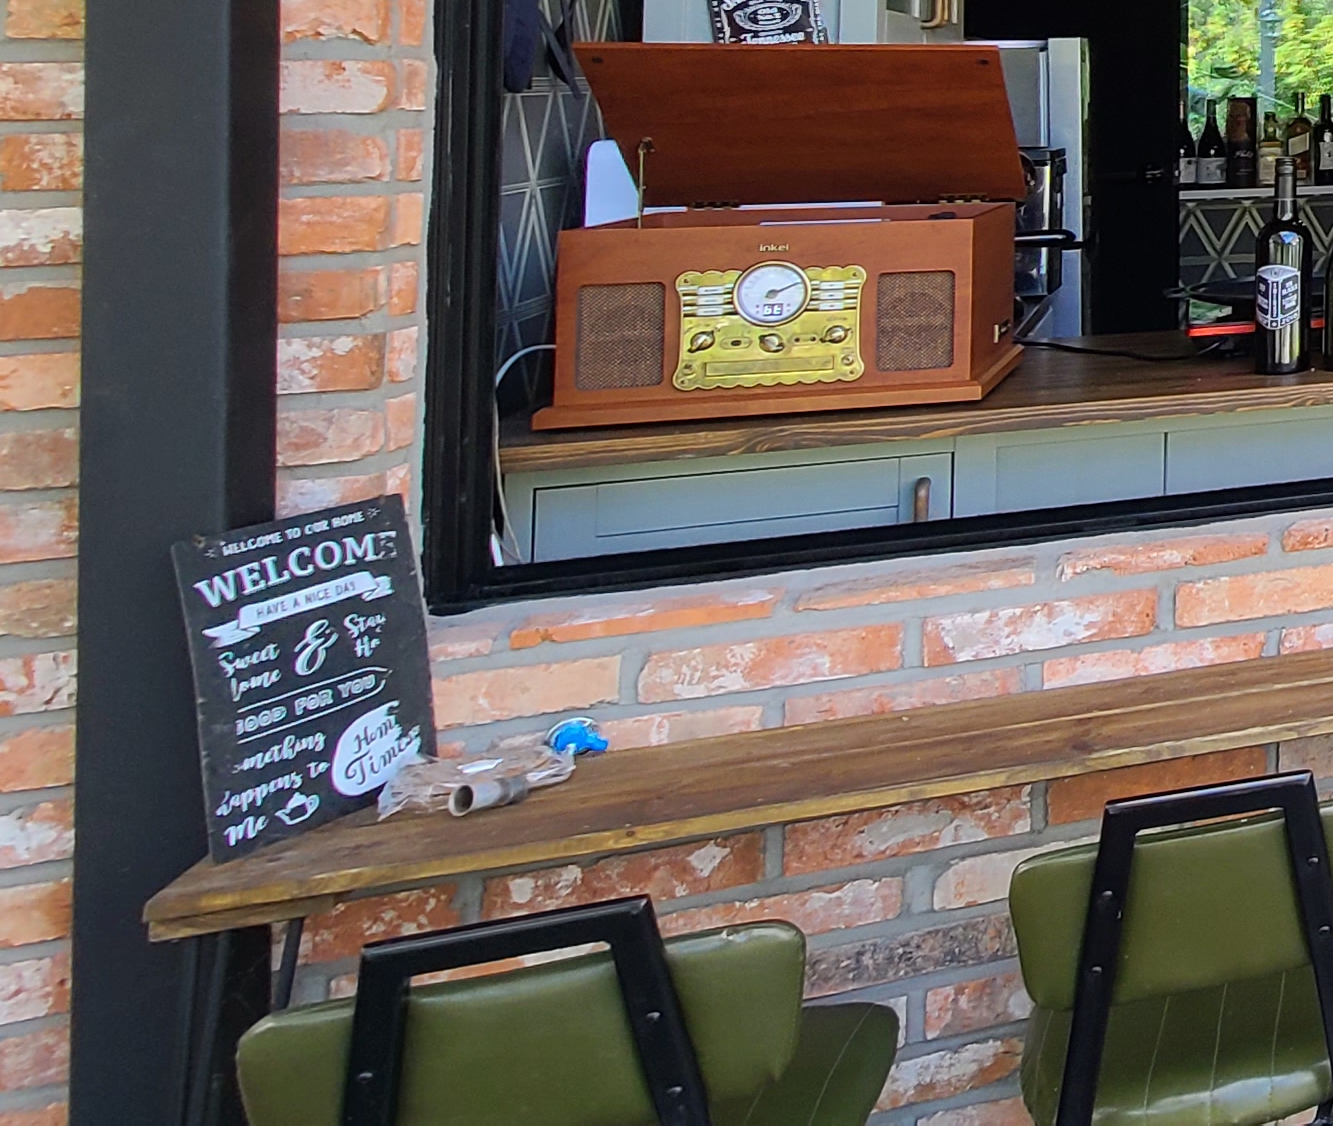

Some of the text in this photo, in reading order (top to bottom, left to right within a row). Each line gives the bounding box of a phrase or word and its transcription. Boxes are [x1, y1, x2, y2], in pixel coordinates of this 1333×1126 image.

[759, 243, 790, 252] inkel
[220, 510, 366, 556] WELCOME TO OUR HOME
[256, 603, 289, 619] HAVE
[292, 598, 300, 609] A
[304, 587, 331, 605] NICE
[293, 619, 339, 676] &
[337, 674, 376, 699] YOU
[306, 760, 331, 779] to
